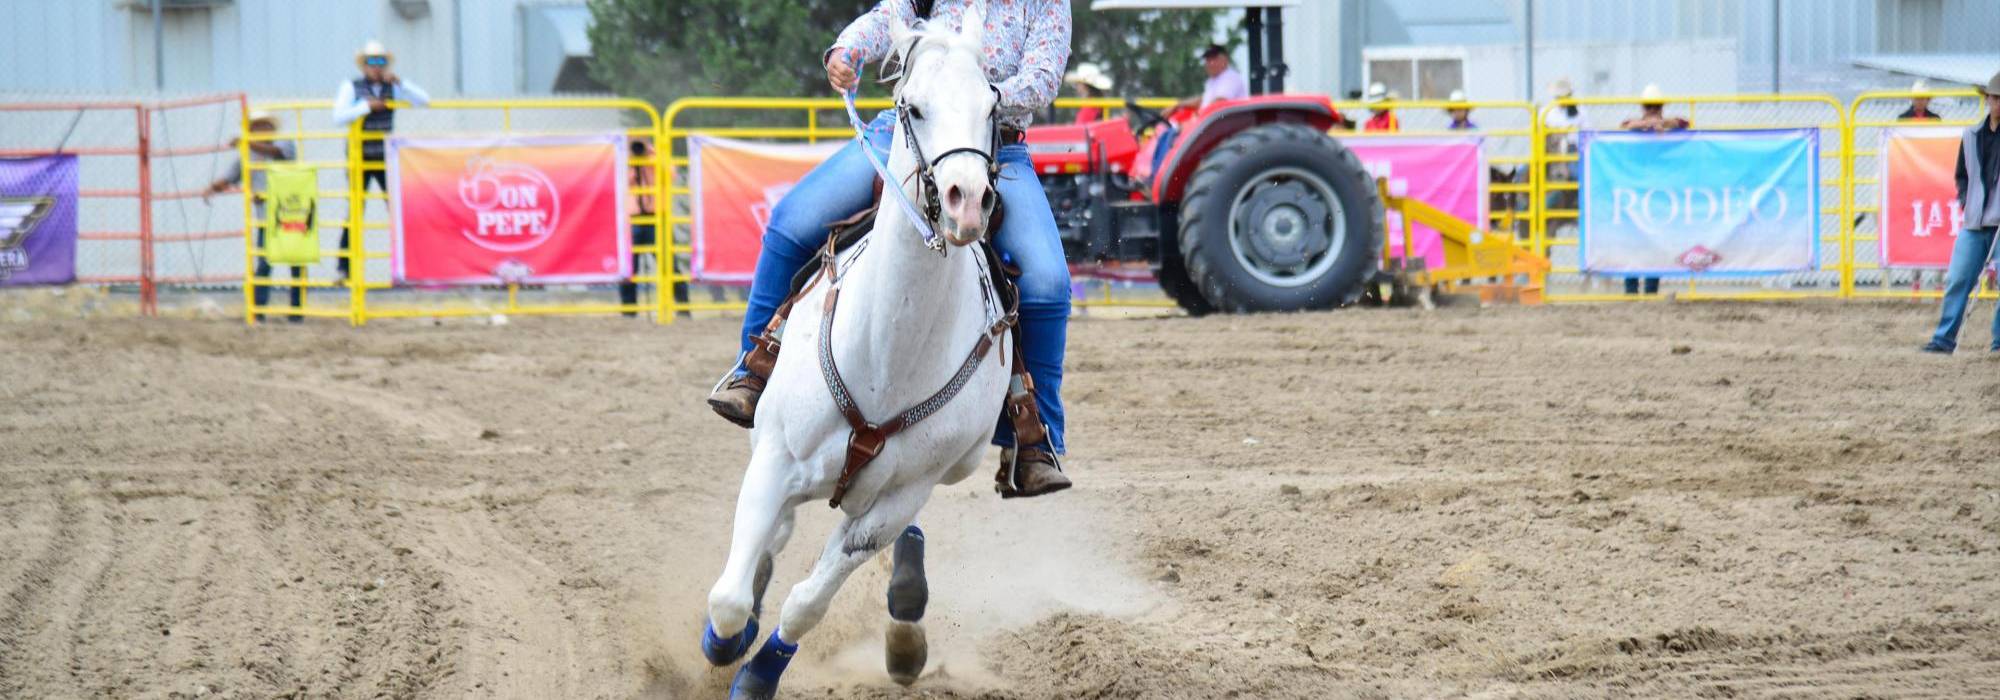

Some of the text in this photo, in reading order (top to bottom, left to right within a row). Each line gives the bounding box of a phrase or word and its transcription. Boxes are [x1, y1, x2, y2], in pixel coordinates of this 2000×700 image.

[478, 211, 546, 236] PEPE
[1611, 185, 1787, 226] RODEO
[1912, 199, 1942, 237] LA
